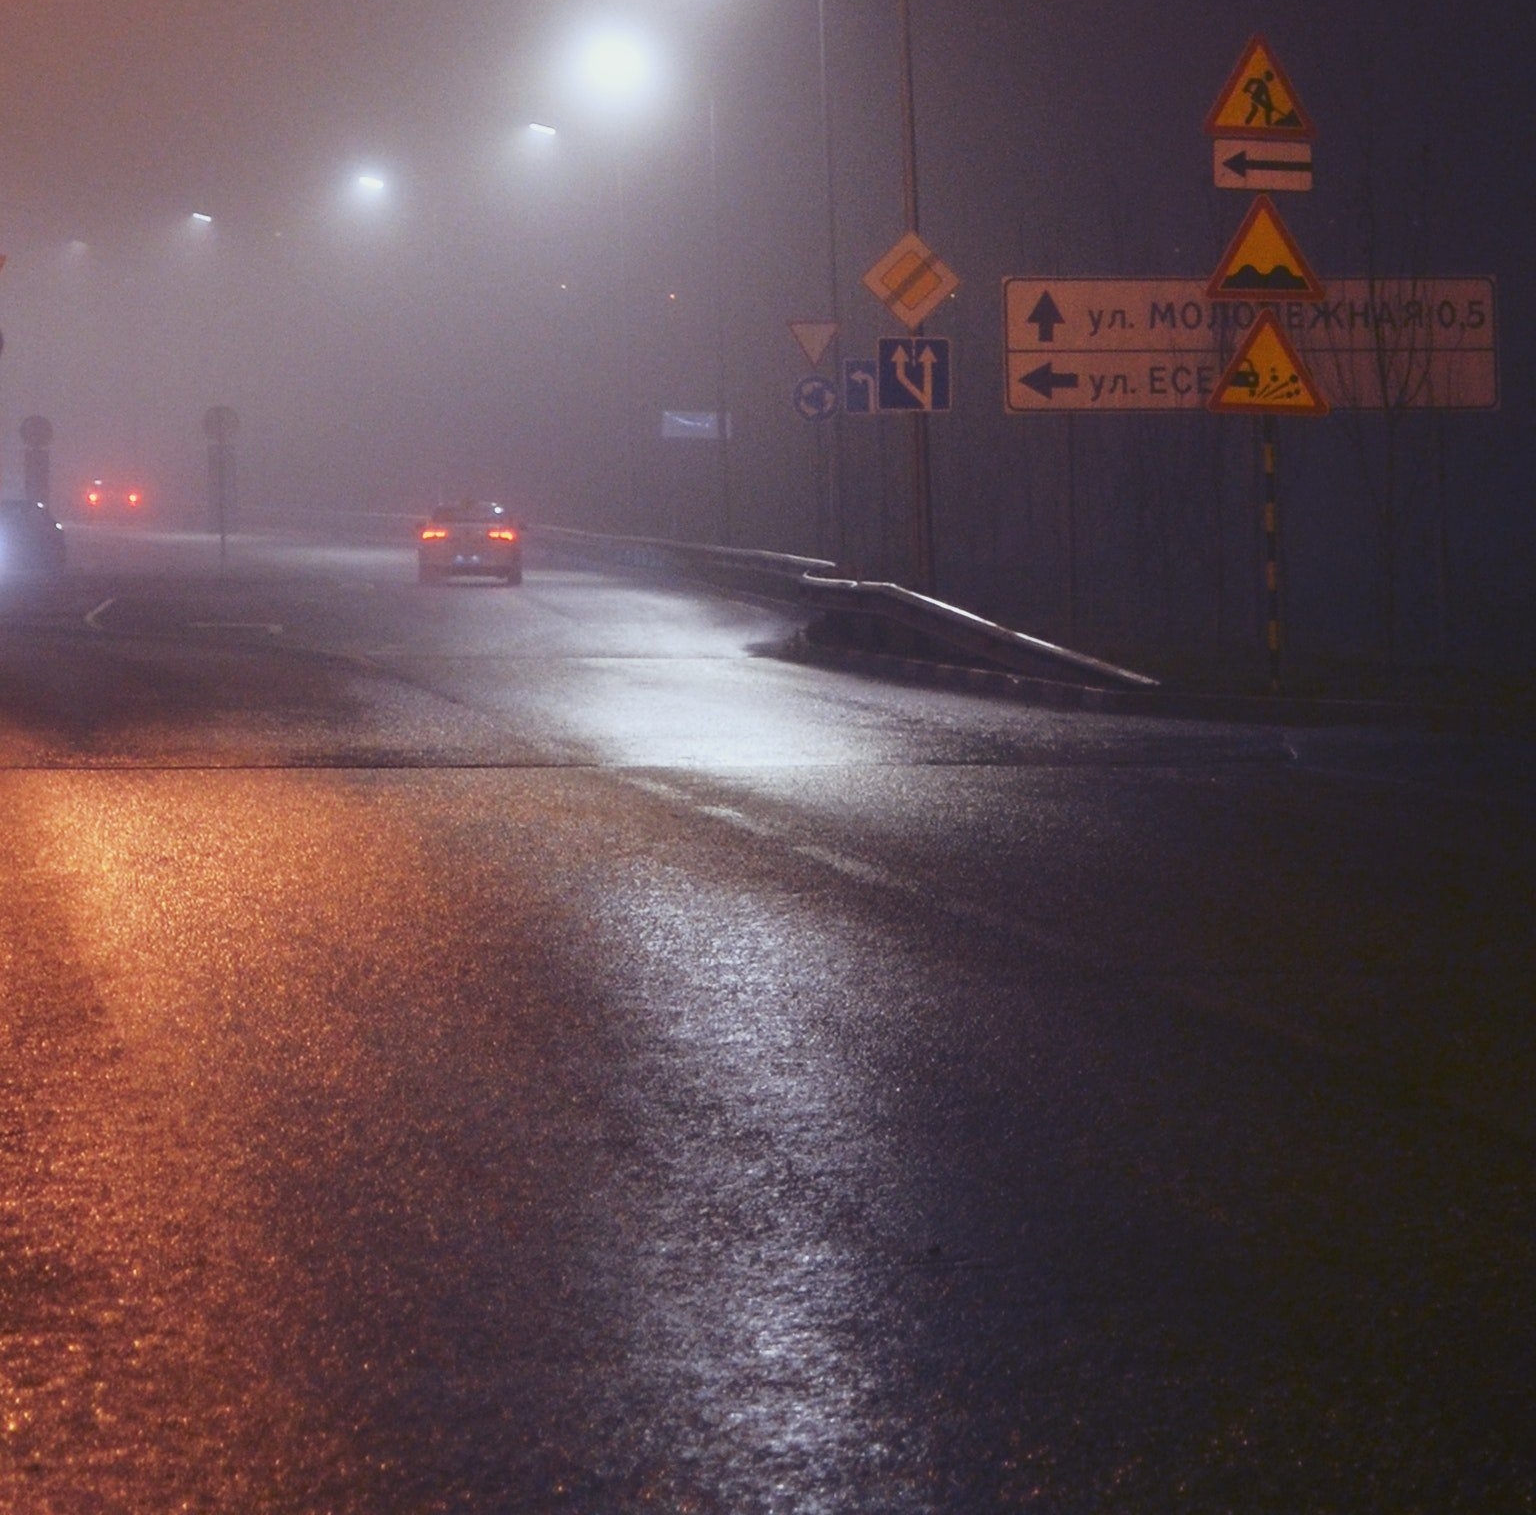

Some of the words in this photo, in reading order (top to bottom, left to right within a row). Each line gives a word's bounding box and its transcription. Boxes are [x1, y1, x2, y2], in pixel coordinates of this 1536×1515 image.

[1088, 309, 1135, 336] ул.
[1436, 300, 1486, 331] 0,5
[1089, 374, 1136, 402] ул.
[1149, 365, 1220, 395] ЕСЕ
